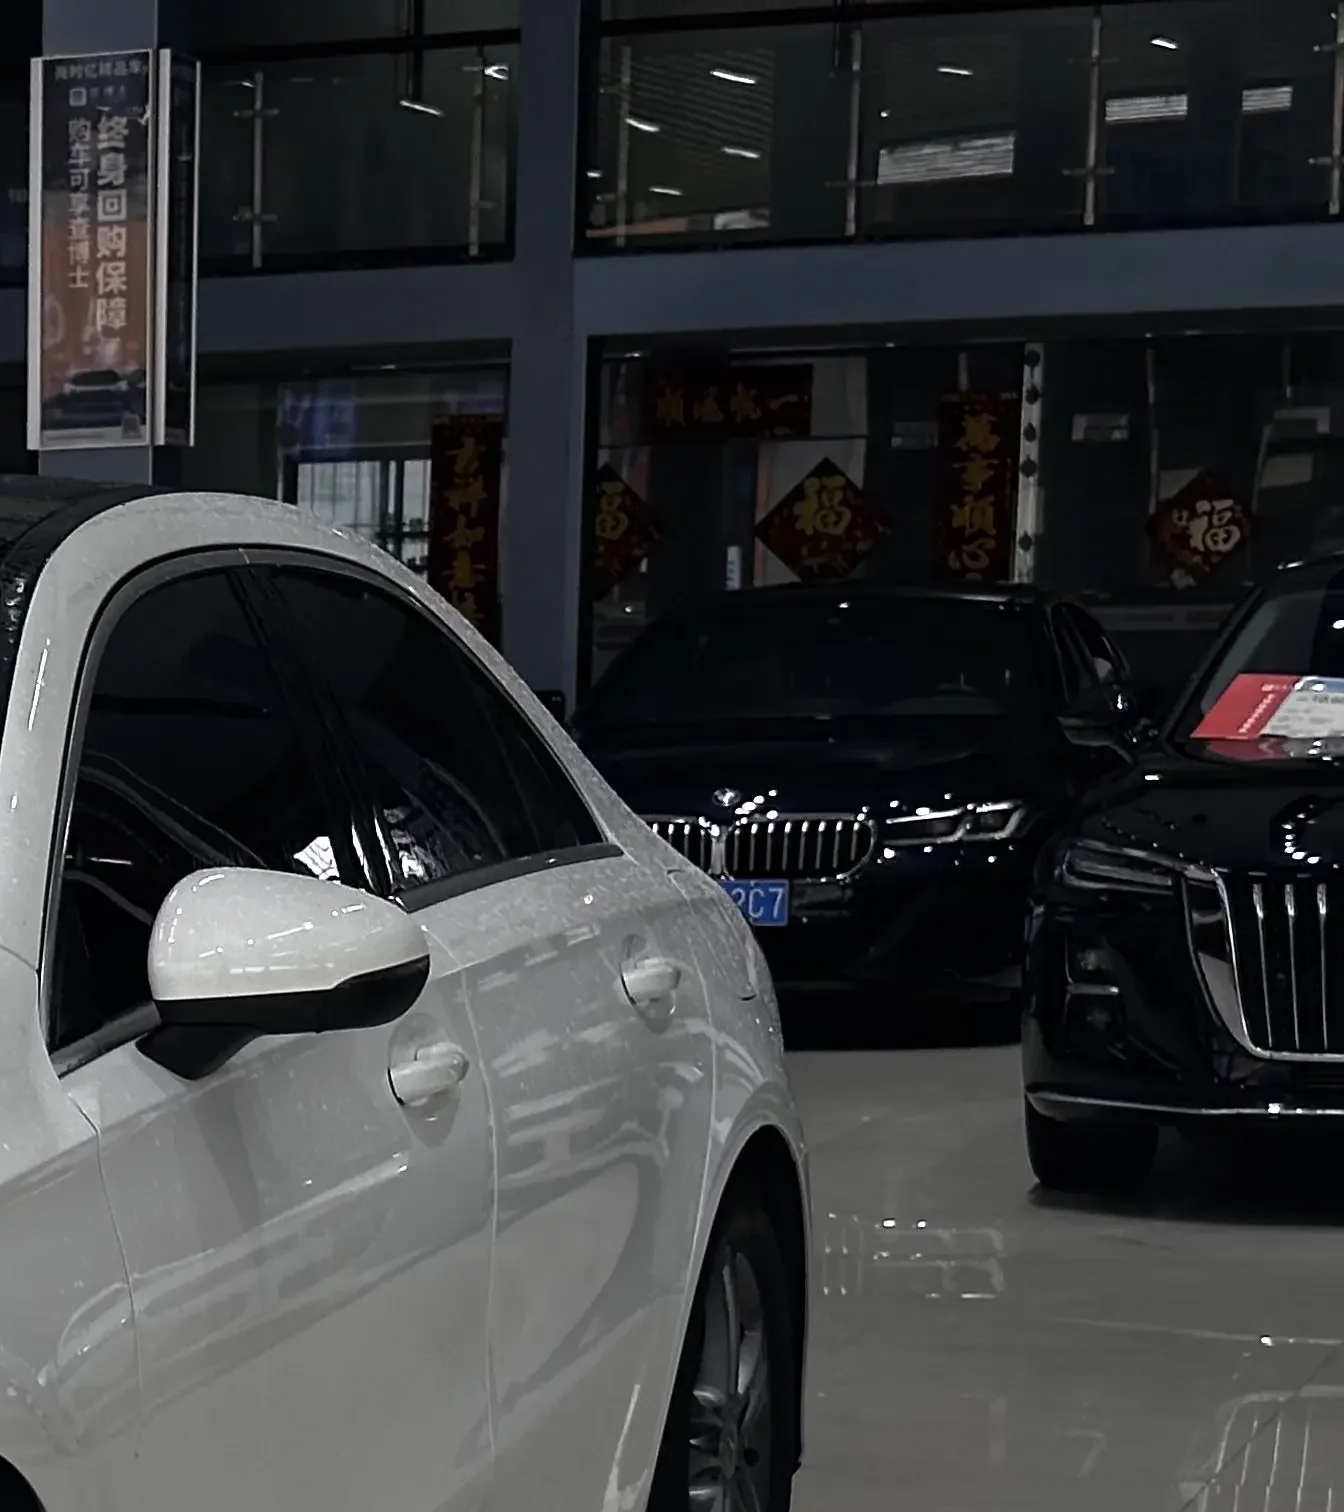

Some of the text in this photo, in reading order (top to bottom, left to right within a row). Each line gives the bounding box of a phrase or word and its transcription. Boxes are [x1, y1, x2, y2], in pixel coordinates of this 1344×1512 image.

[67, 117, 91, 288] 购车可享查博士
[96, 115, 129, 332] 终身回购保障
[793, 474, 852, 536] 福
[1187, 498, 1241, 553] 福
